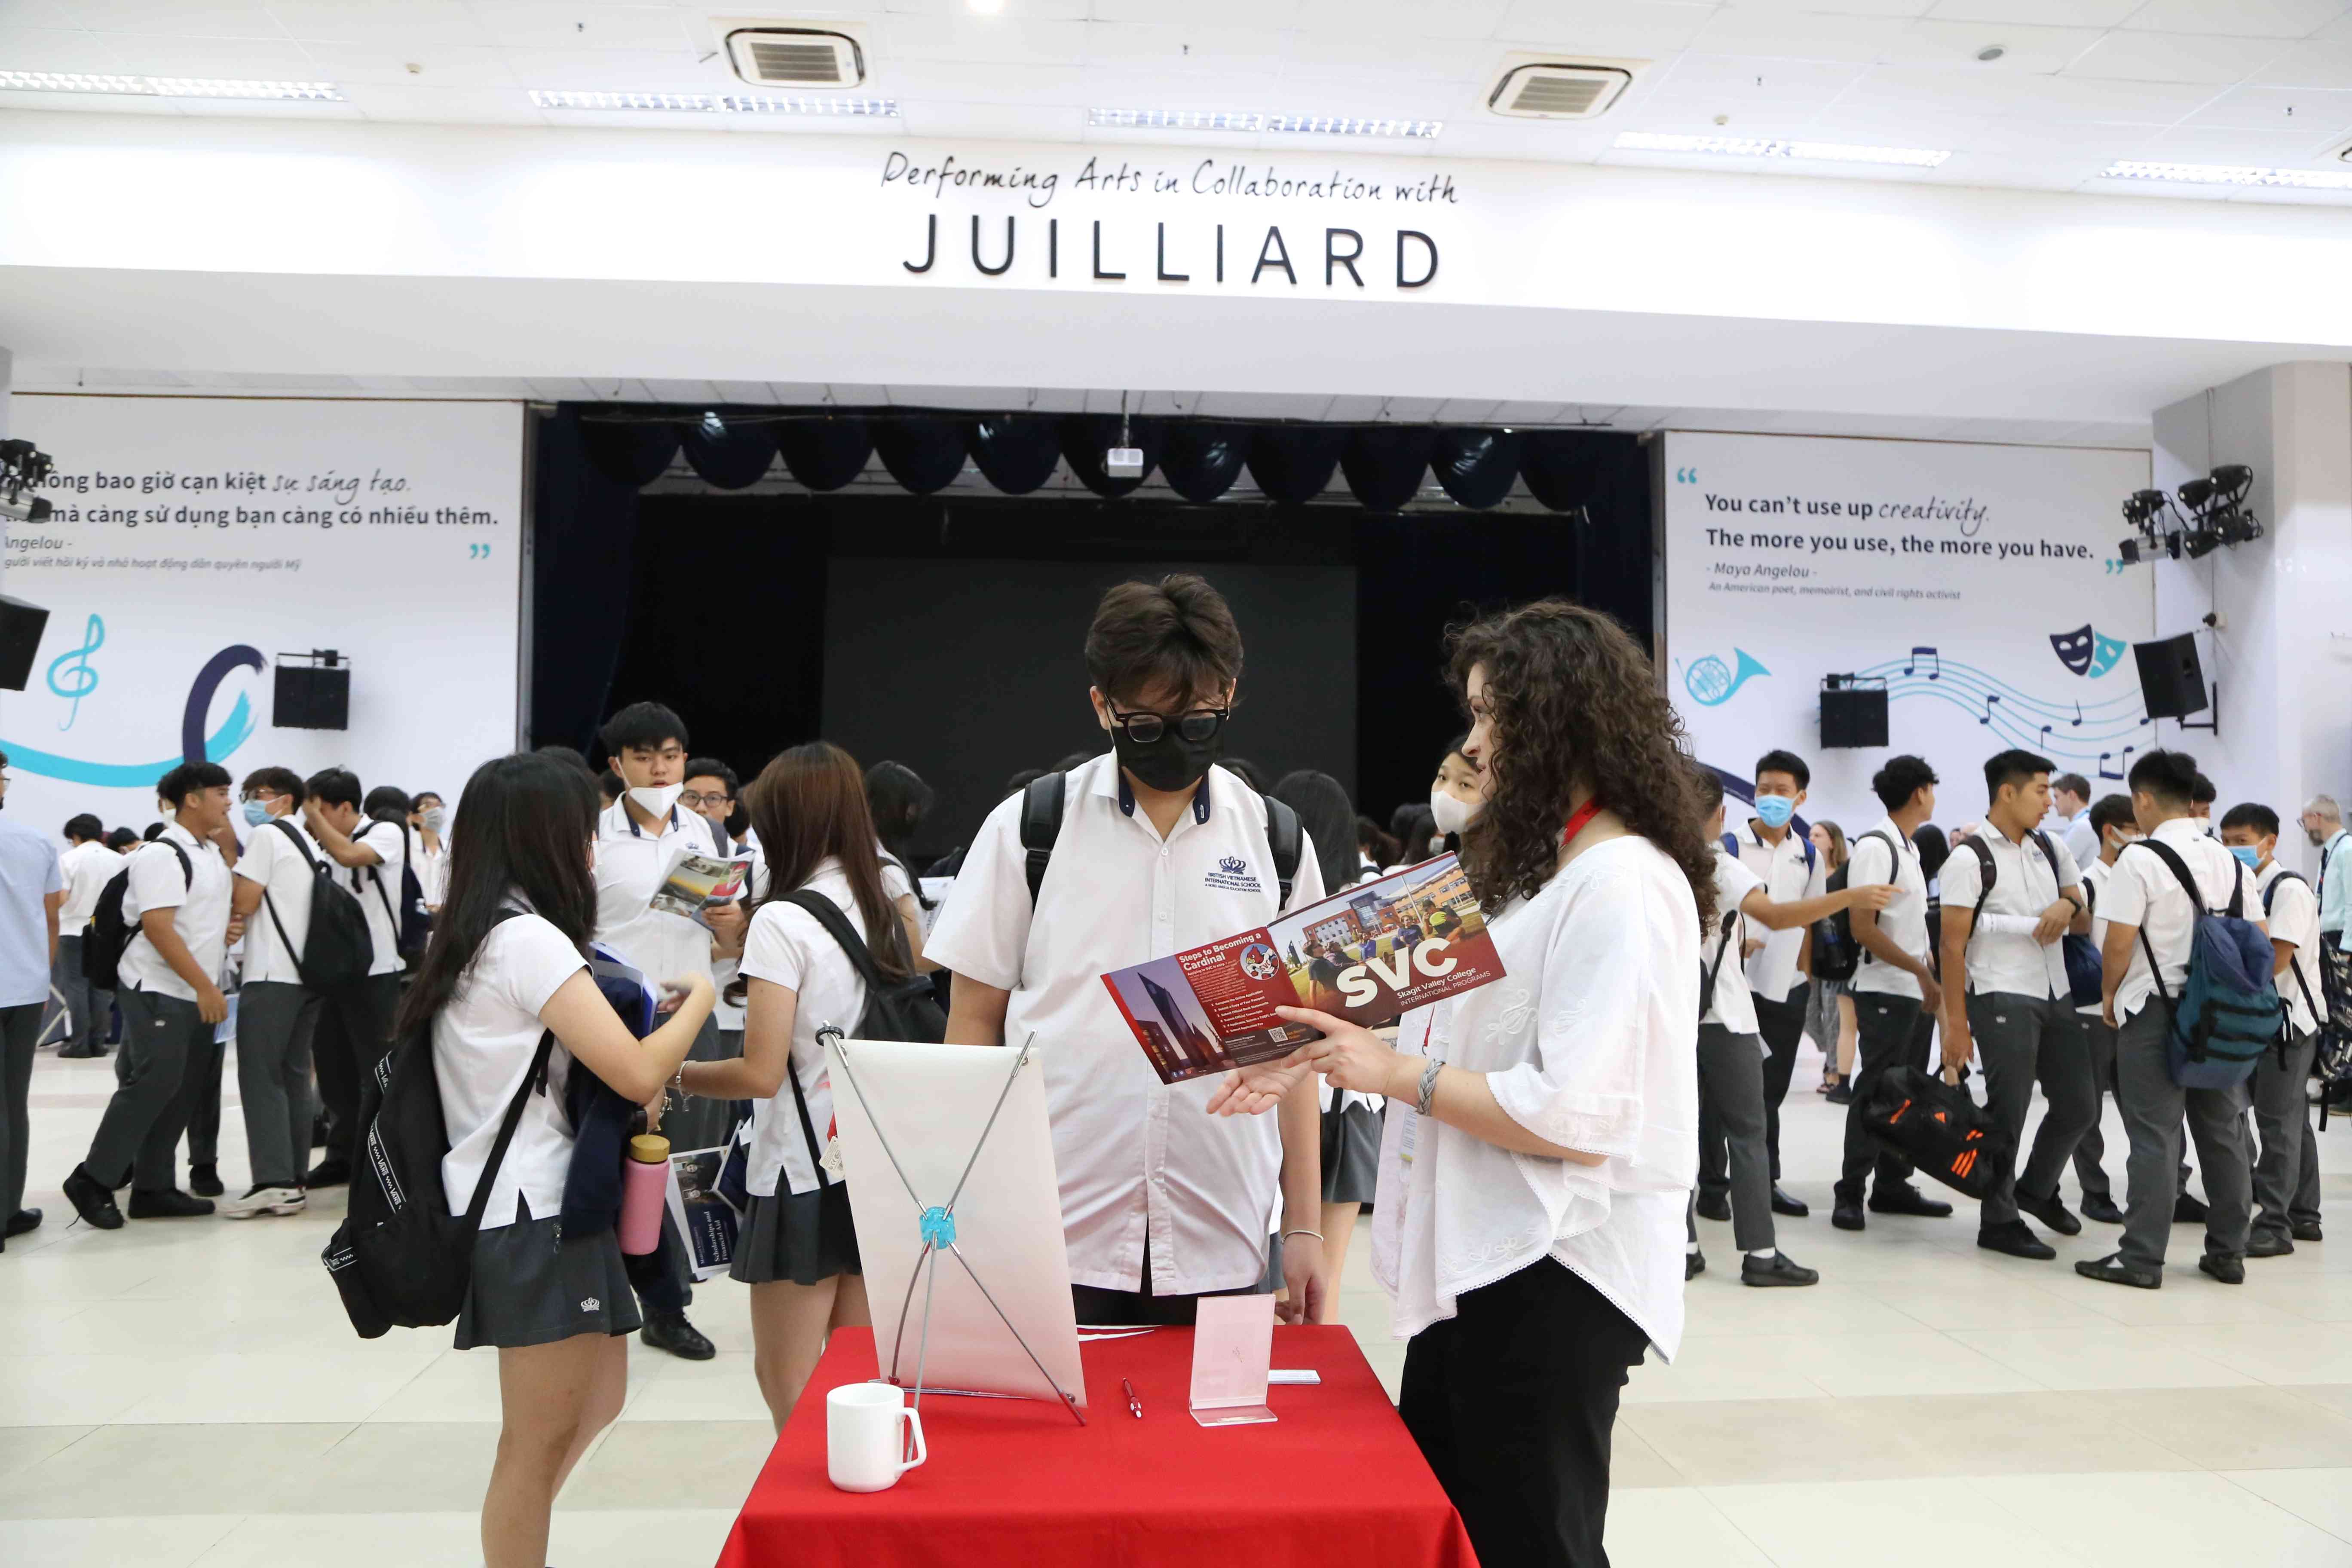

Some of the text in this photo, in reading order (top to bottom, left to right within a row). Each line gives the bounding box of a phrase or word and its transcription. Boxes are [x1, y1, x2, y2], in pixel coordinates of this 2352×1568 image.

[881, 151, 1459, 208] Performing Arts in Collaboration with
[902, 214, 1439, 289] JUILLIARD
[34, 469, 89, 493] ông
[96, 472, 135, 489] bao
[142, 471, 175, 494] giờ
[181, 475, 218, 495] cạn
[226, 472, 266, 495] kiệt
[306, 469, 360, 505] sáng
[50, 503, 80, 523] mà
[87, 503, 138, 528] càng
[144, 503, 170, 523] sử
[175, 505, 229, 529] dụng
[236, 505, 276, 529] bạn
[282, 504, 333, 529] càng
[340, 505, 363, 524] có
[435, 506, 499, 524] thêm.
[1705, 493, 1990, 537] You can't use up creativity.
[1706, 528, 2094, 559] The more you use, the more you have.
[1714, 562, 1751, 579] Maya
[1754, 563, 1810, 580] Angelou
[1709, 582, 1961, 601] An American poet, memoirist, and civil rights activist
[1205, 877, 1240, 886] INTERNATIONAL
[1179, 951, 1202, 963] Steps
[1212, 934, 1255, 953] Becoming
[1183, 952, 1226, 971] Cardinal
[1259, 959, 1271, 971] SVC
[1336, 937, 1458, 1008] SVC
[1396, 966, 1476, 999] Skagit Valley College
[1400, 970, 1491, 1007] INTERNATIONAL PROGRAMS
[377, 1158, 389, 1176] VANS
[390, 1187, 402, 1206] VANS
[704, 1211, 720, 1262] Scholarships and
[717, 1232, 728, 1260] Financial
